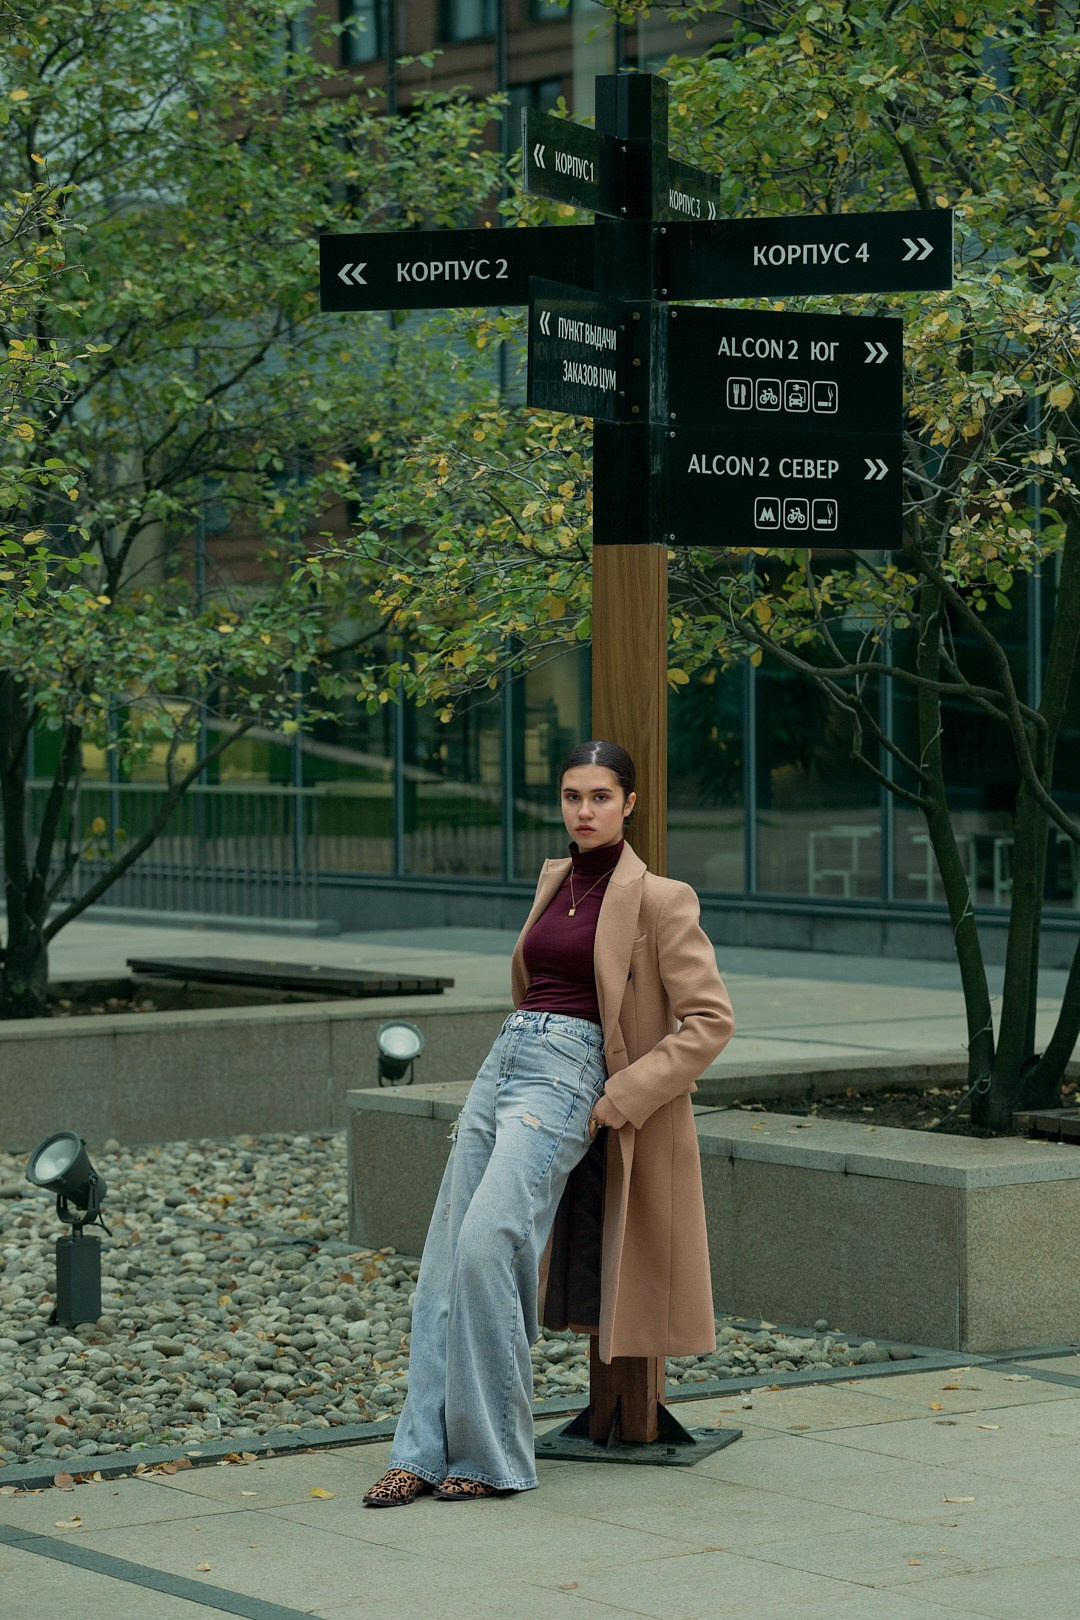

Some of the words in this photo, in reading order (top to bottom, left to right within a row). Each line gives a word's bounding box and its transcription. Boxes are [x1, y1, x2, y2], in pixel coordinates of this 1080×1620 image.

[555, 150, 590, 182] КОРПУС
[668, 188, 696, 217] КОРПУС
[752, 242, 850, 267] КОРПУС
[854, 242, 870, 263] 4
[396, 260, 491, 283] КОРПУС
[495, 258, 509, 279] 2
[557, 316, 585, 343] ПУНКТ
[584, 323, 617, 352] ВЫДАЧИ
[717, 336, 783, 360] ALCON
[787, 339, 799, 361] 2
[810, 341, 840, 362] ЮГ
[562, 359, 599, 387] ЗАКАЗОВ
[599, 367, 617, 393] ЦУМ
[687, 453, 754, 477] ALCON
[758, 456, 770, 477] 2
[778, 457, 840, 480] СЕВЕР
